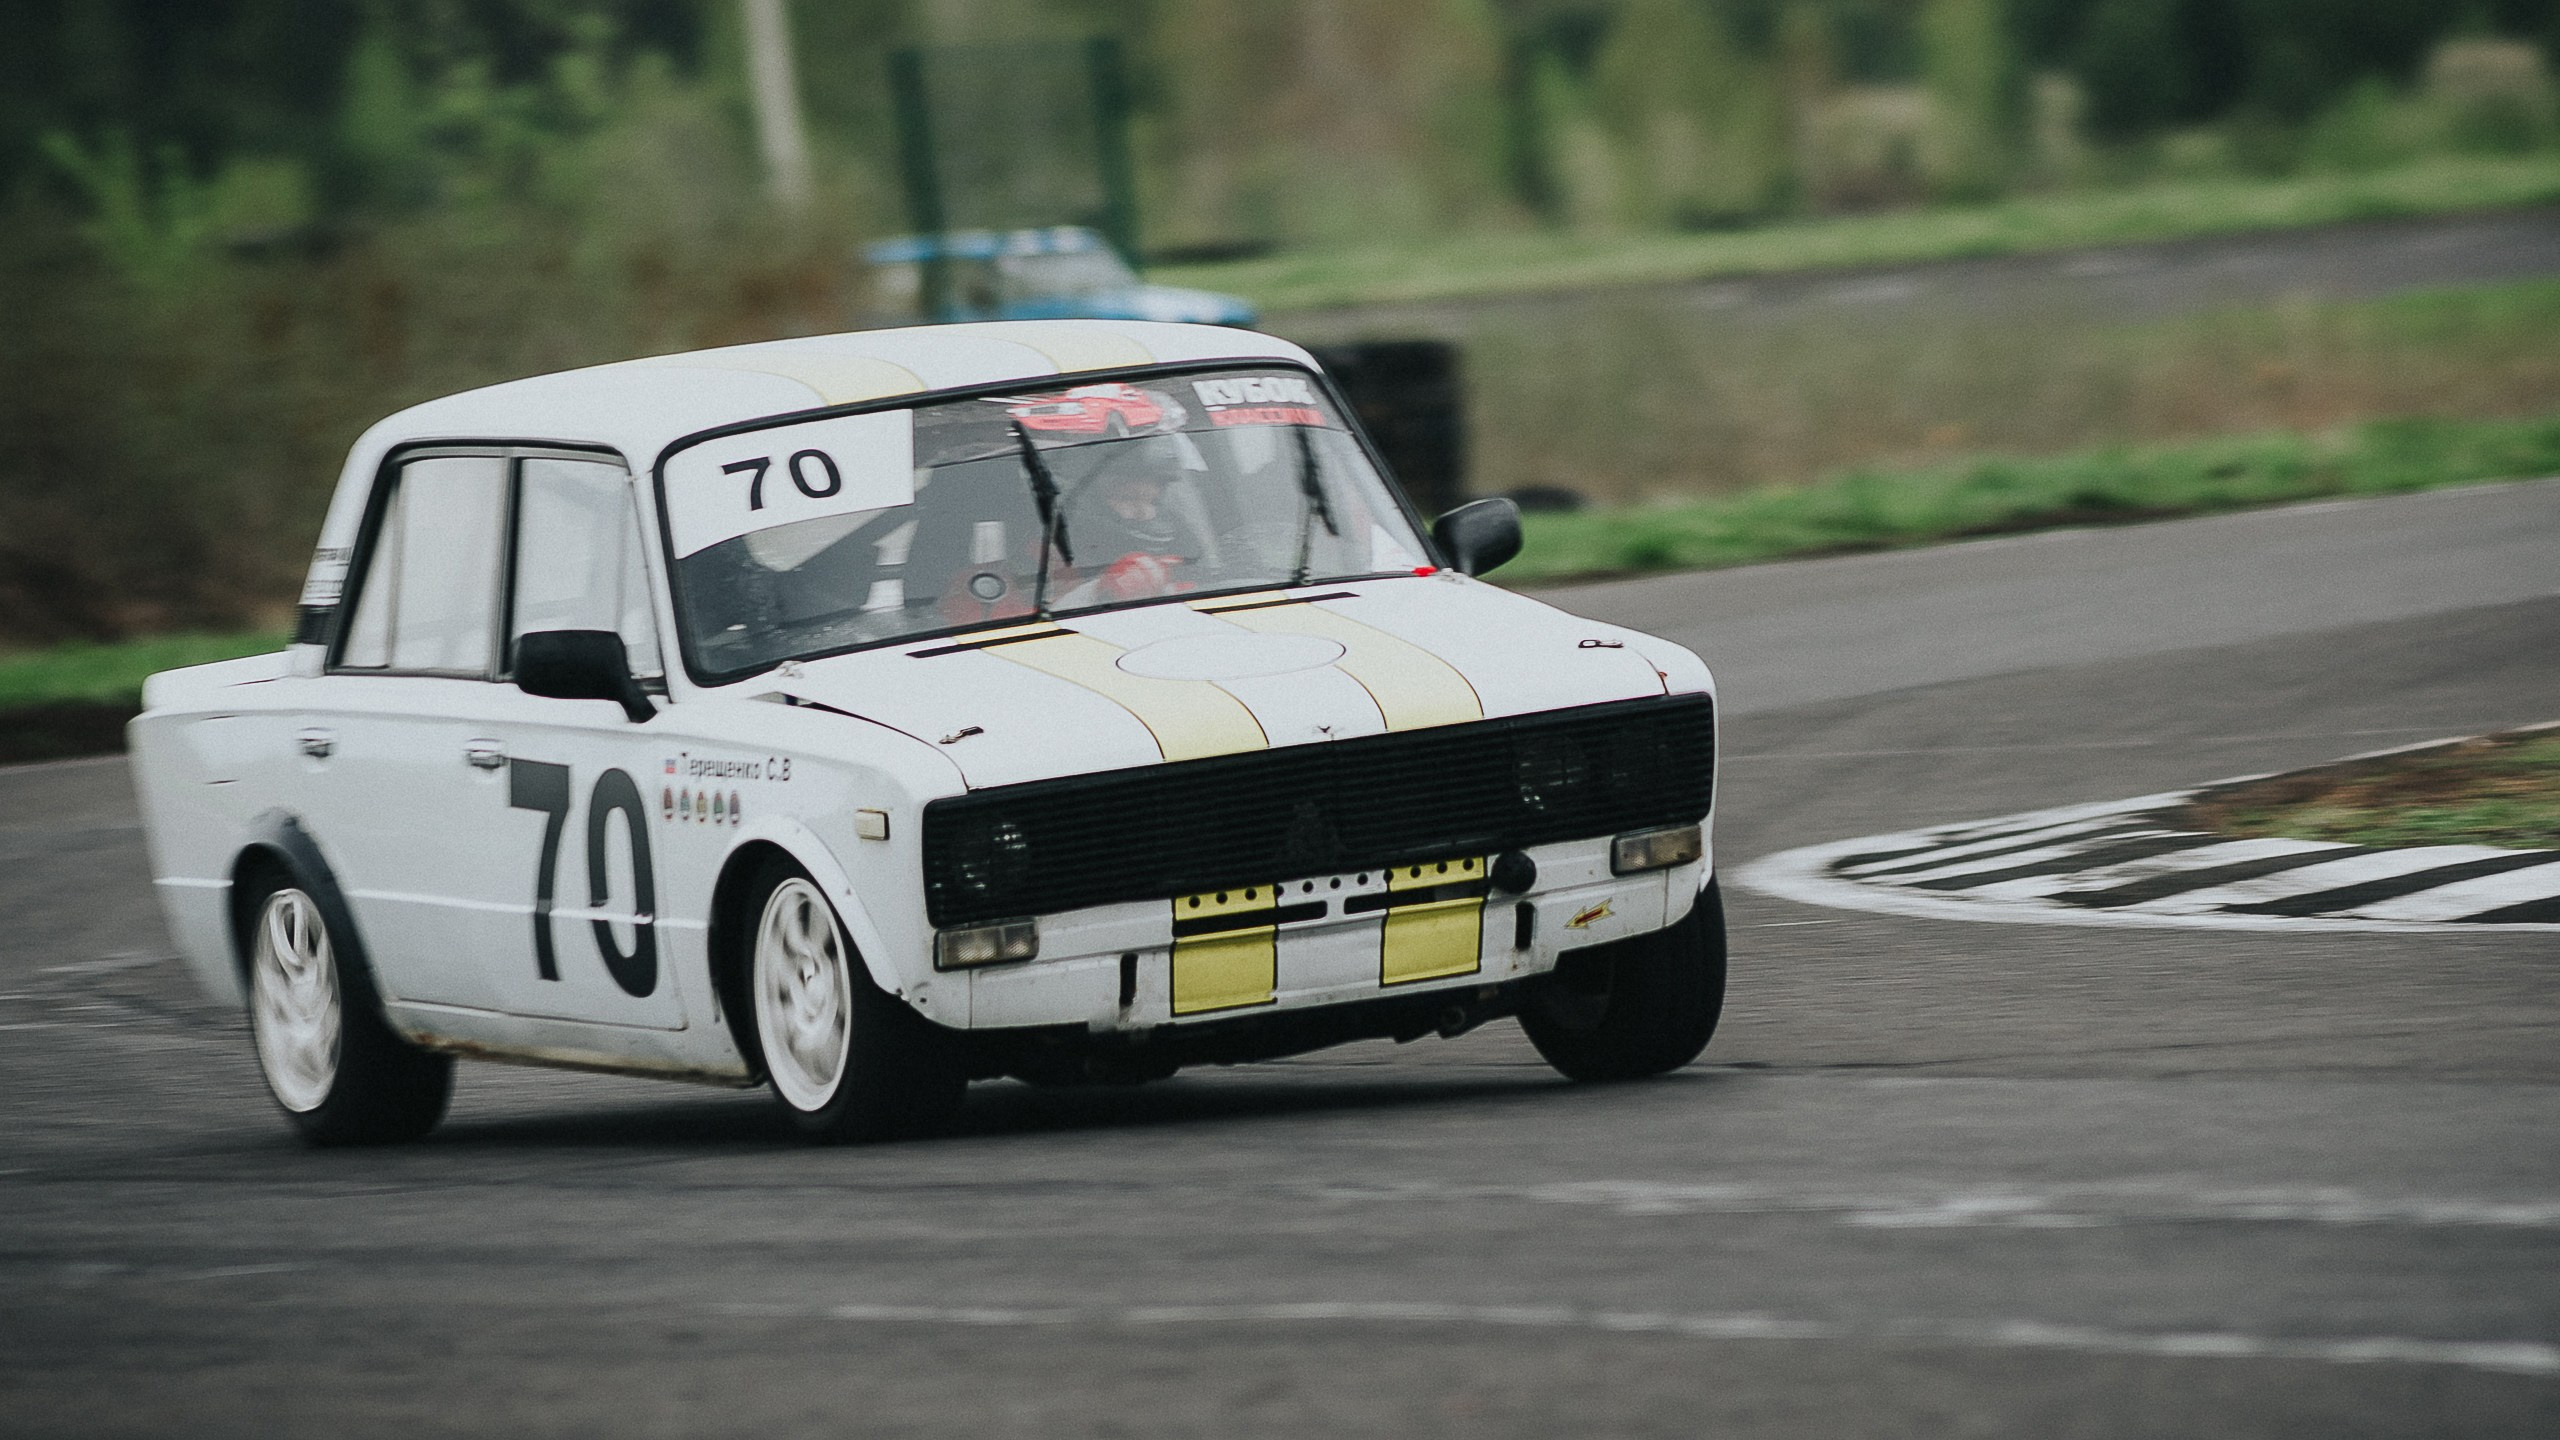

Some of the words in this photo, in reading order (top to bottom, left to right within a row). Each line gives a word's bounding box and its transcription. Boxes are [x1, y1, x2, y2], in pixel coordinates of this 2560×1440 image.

[1192, 376, 1317, 406] КУБОК
[721, 449, 842, 511] 70
[510, 757, 658, 998] 70
